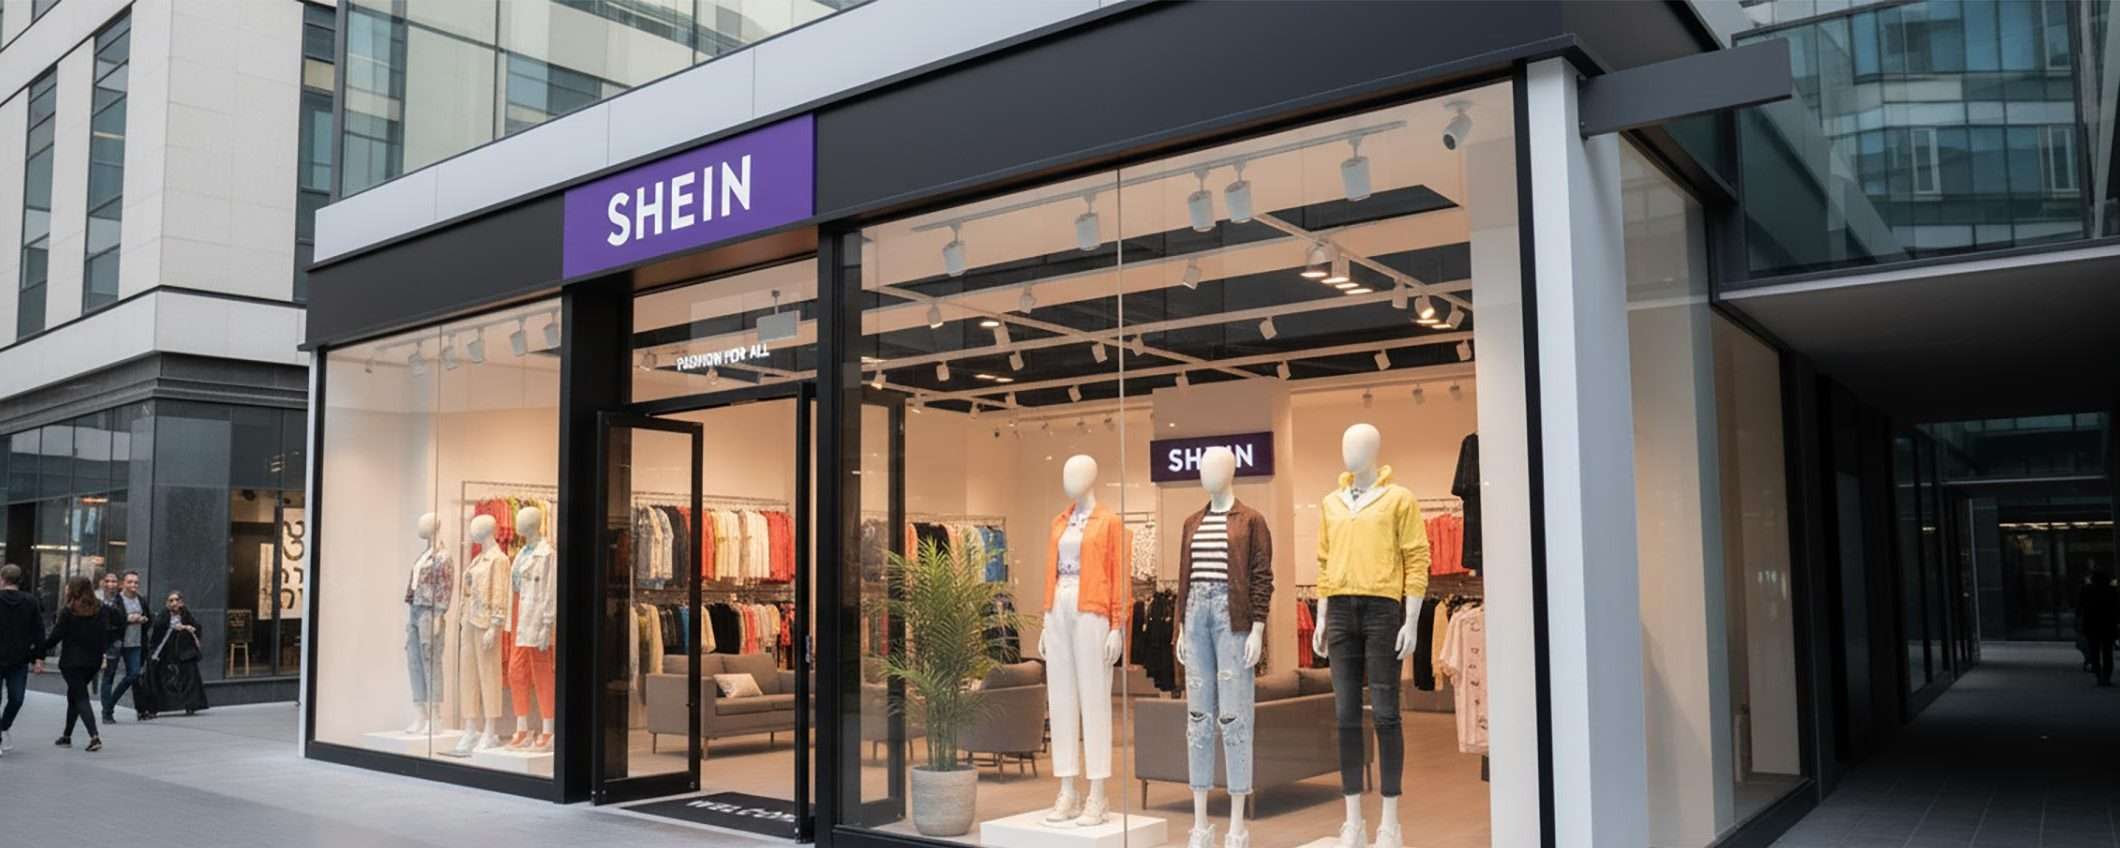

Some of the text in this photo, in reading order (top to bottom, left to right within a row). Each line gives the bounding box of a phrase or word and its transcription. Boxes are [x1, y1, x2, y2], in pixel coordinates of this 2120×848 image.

[607, 154, 751, 247] SHEIN
[750, 343, 770, 359] ALL
[1168, 444, 1253, 472] SHN
